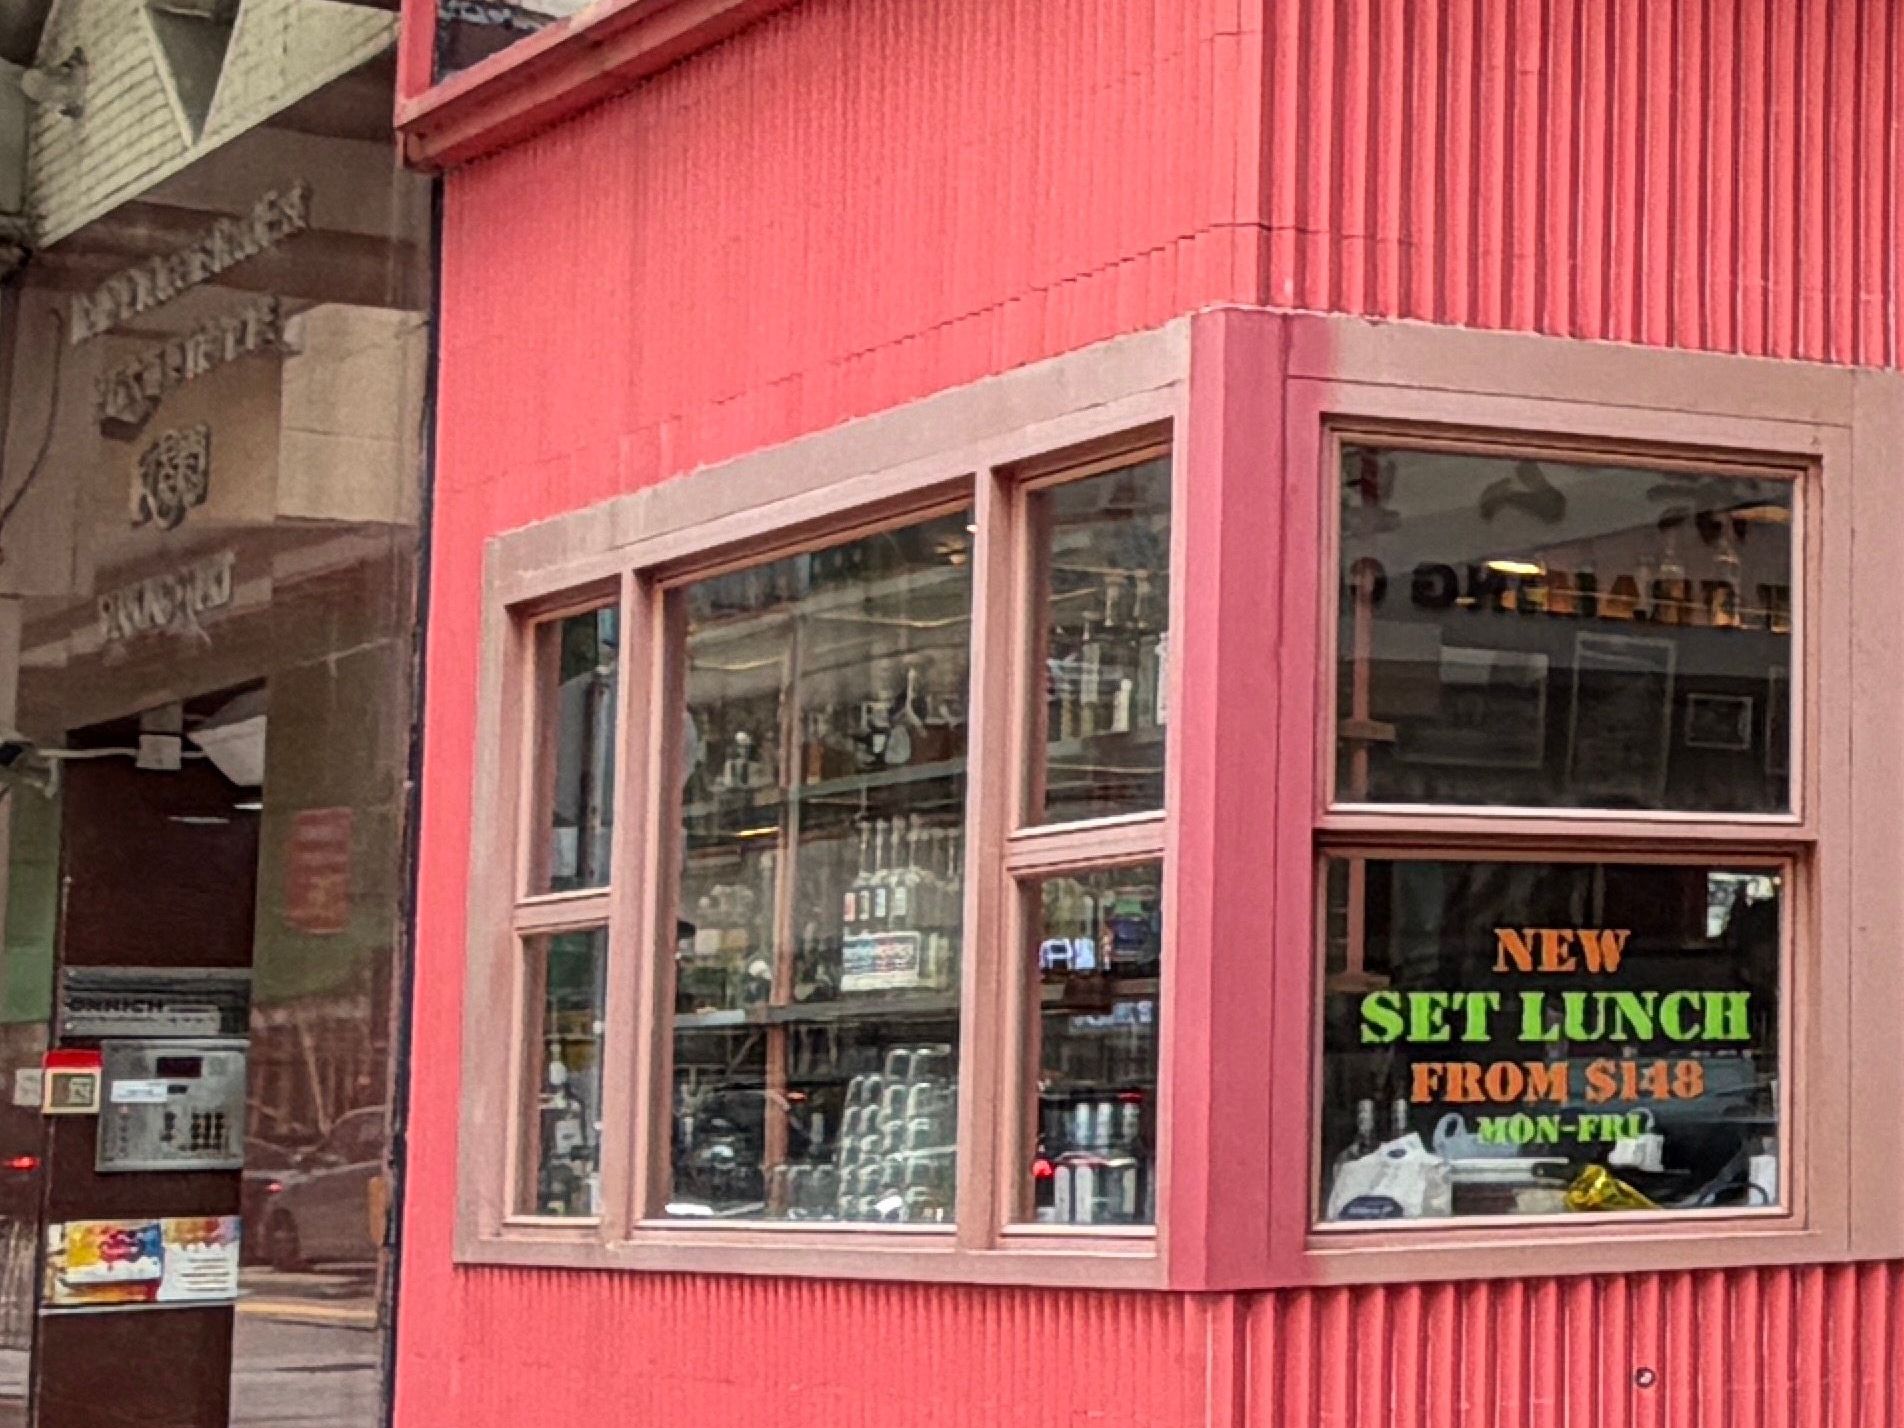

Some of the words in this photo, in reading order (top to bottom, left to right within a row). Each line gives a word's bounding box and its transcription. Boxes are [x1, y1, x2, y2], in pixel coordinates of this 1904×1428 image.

[1492, 928, 1631, 973] NEW
[1360, 990, 1501, 1043] SET
[1518, 990, 1752, 1042] LUNCH
[1410, 1060, 1569, 1104] FROM
[1585, 1058, 1705, 1103] $148
[1476, 1113, 1644, 1145] MON-FRI
